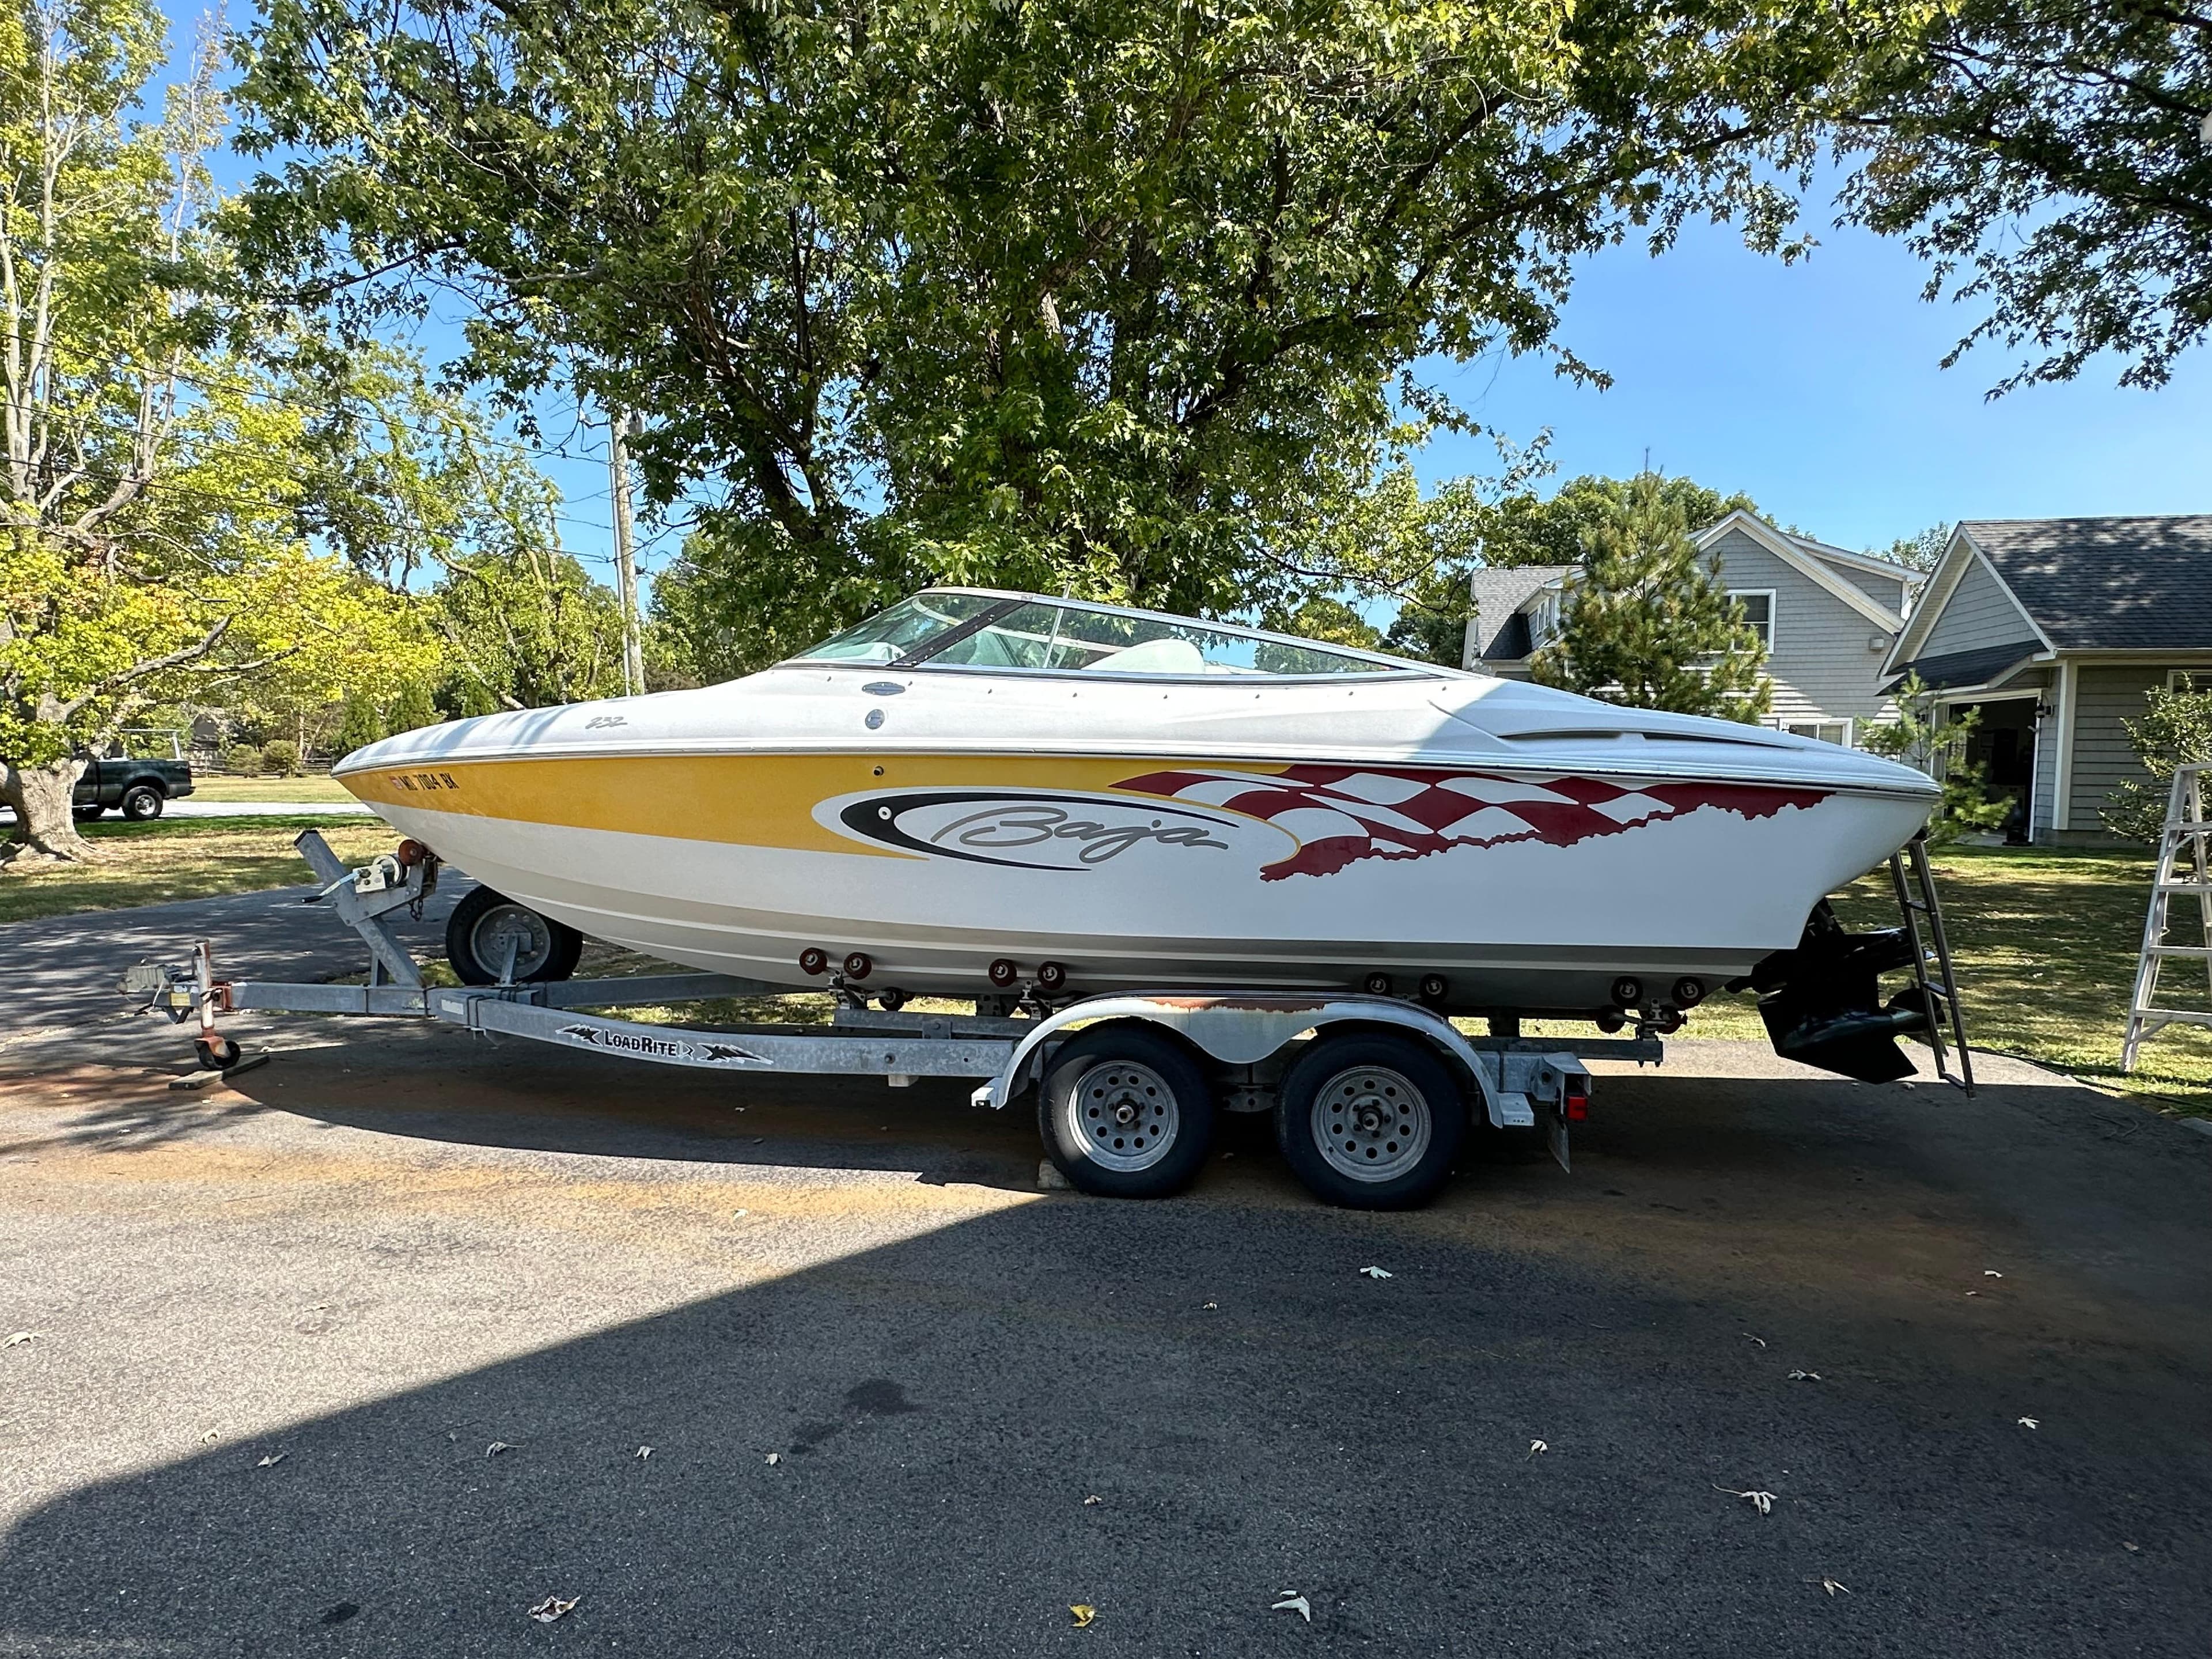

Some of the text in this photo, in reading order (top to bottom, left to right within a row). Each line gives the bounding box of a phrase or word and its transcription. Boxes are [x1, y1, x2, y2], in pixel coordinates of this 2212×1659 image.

[585, 716, 628, 729] 232
[412, 774, 443, 791] 7004
[930, 806, 1229, 863] Baja
